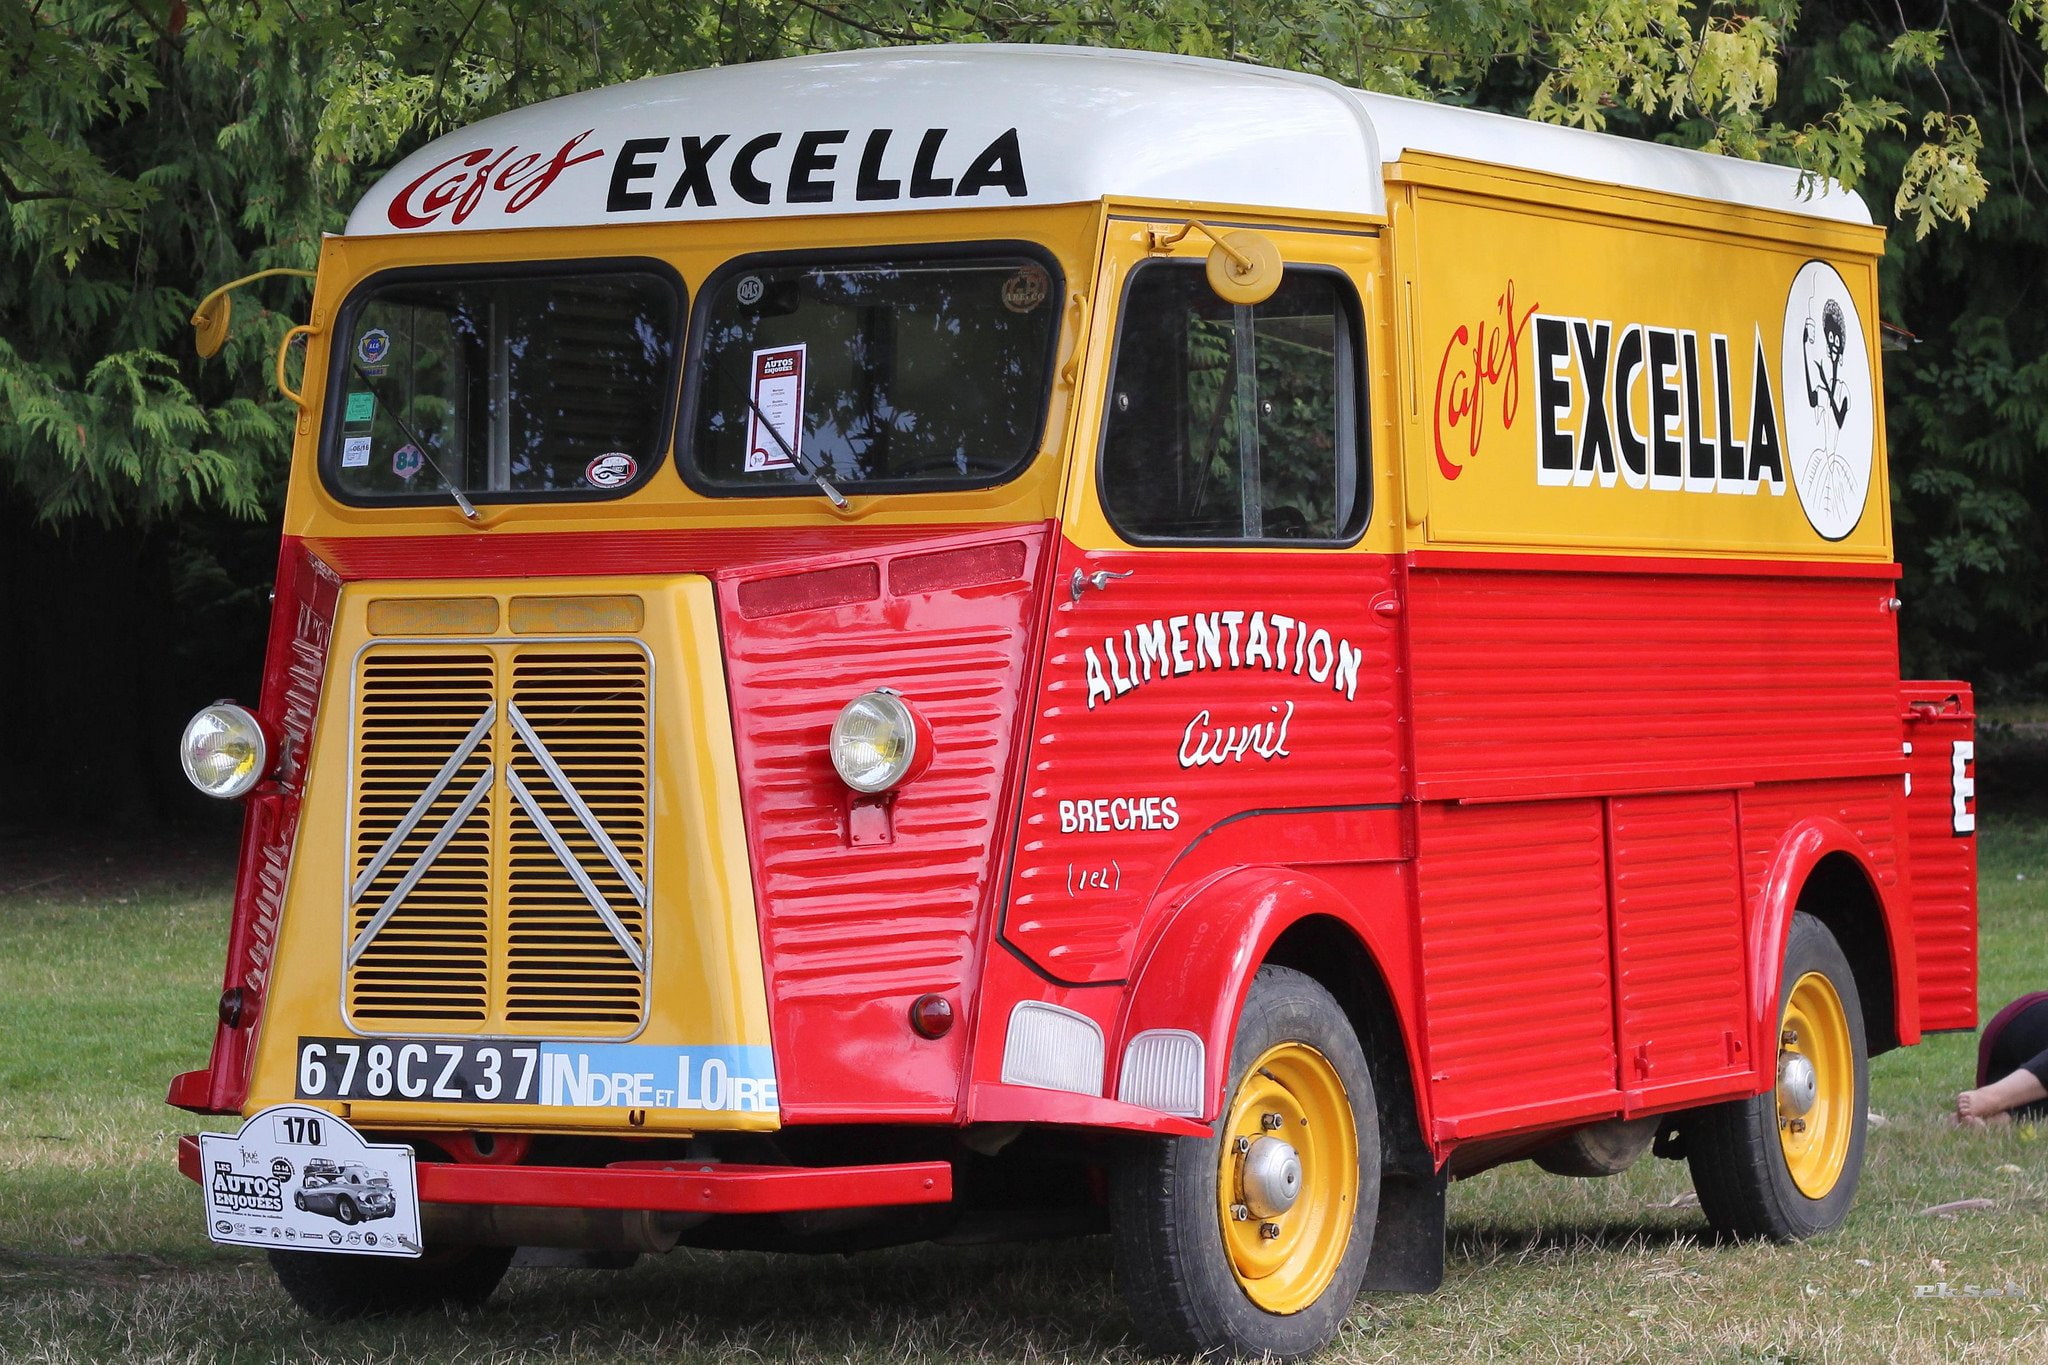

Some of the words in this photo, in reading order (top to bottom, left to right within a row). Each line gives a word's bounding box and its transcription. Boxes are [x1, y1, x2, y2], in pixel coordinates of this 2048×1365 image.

[605, 127, 1029, 213] EXCELLA
[764, 358, 794, 369] AUTOS
[1531, 313, 1787, 496] EXCELLA
[396, 452, 419, 471] 84
[1084, 611, 1362, 711] ALIMENTATION
[1059, 797, 1180, 833] BRECHES
[283, 1117, 321, 1145] 170
[215, 1163, 231, 1172] LES
[214, 1174, 280, 1197] AUTOS
